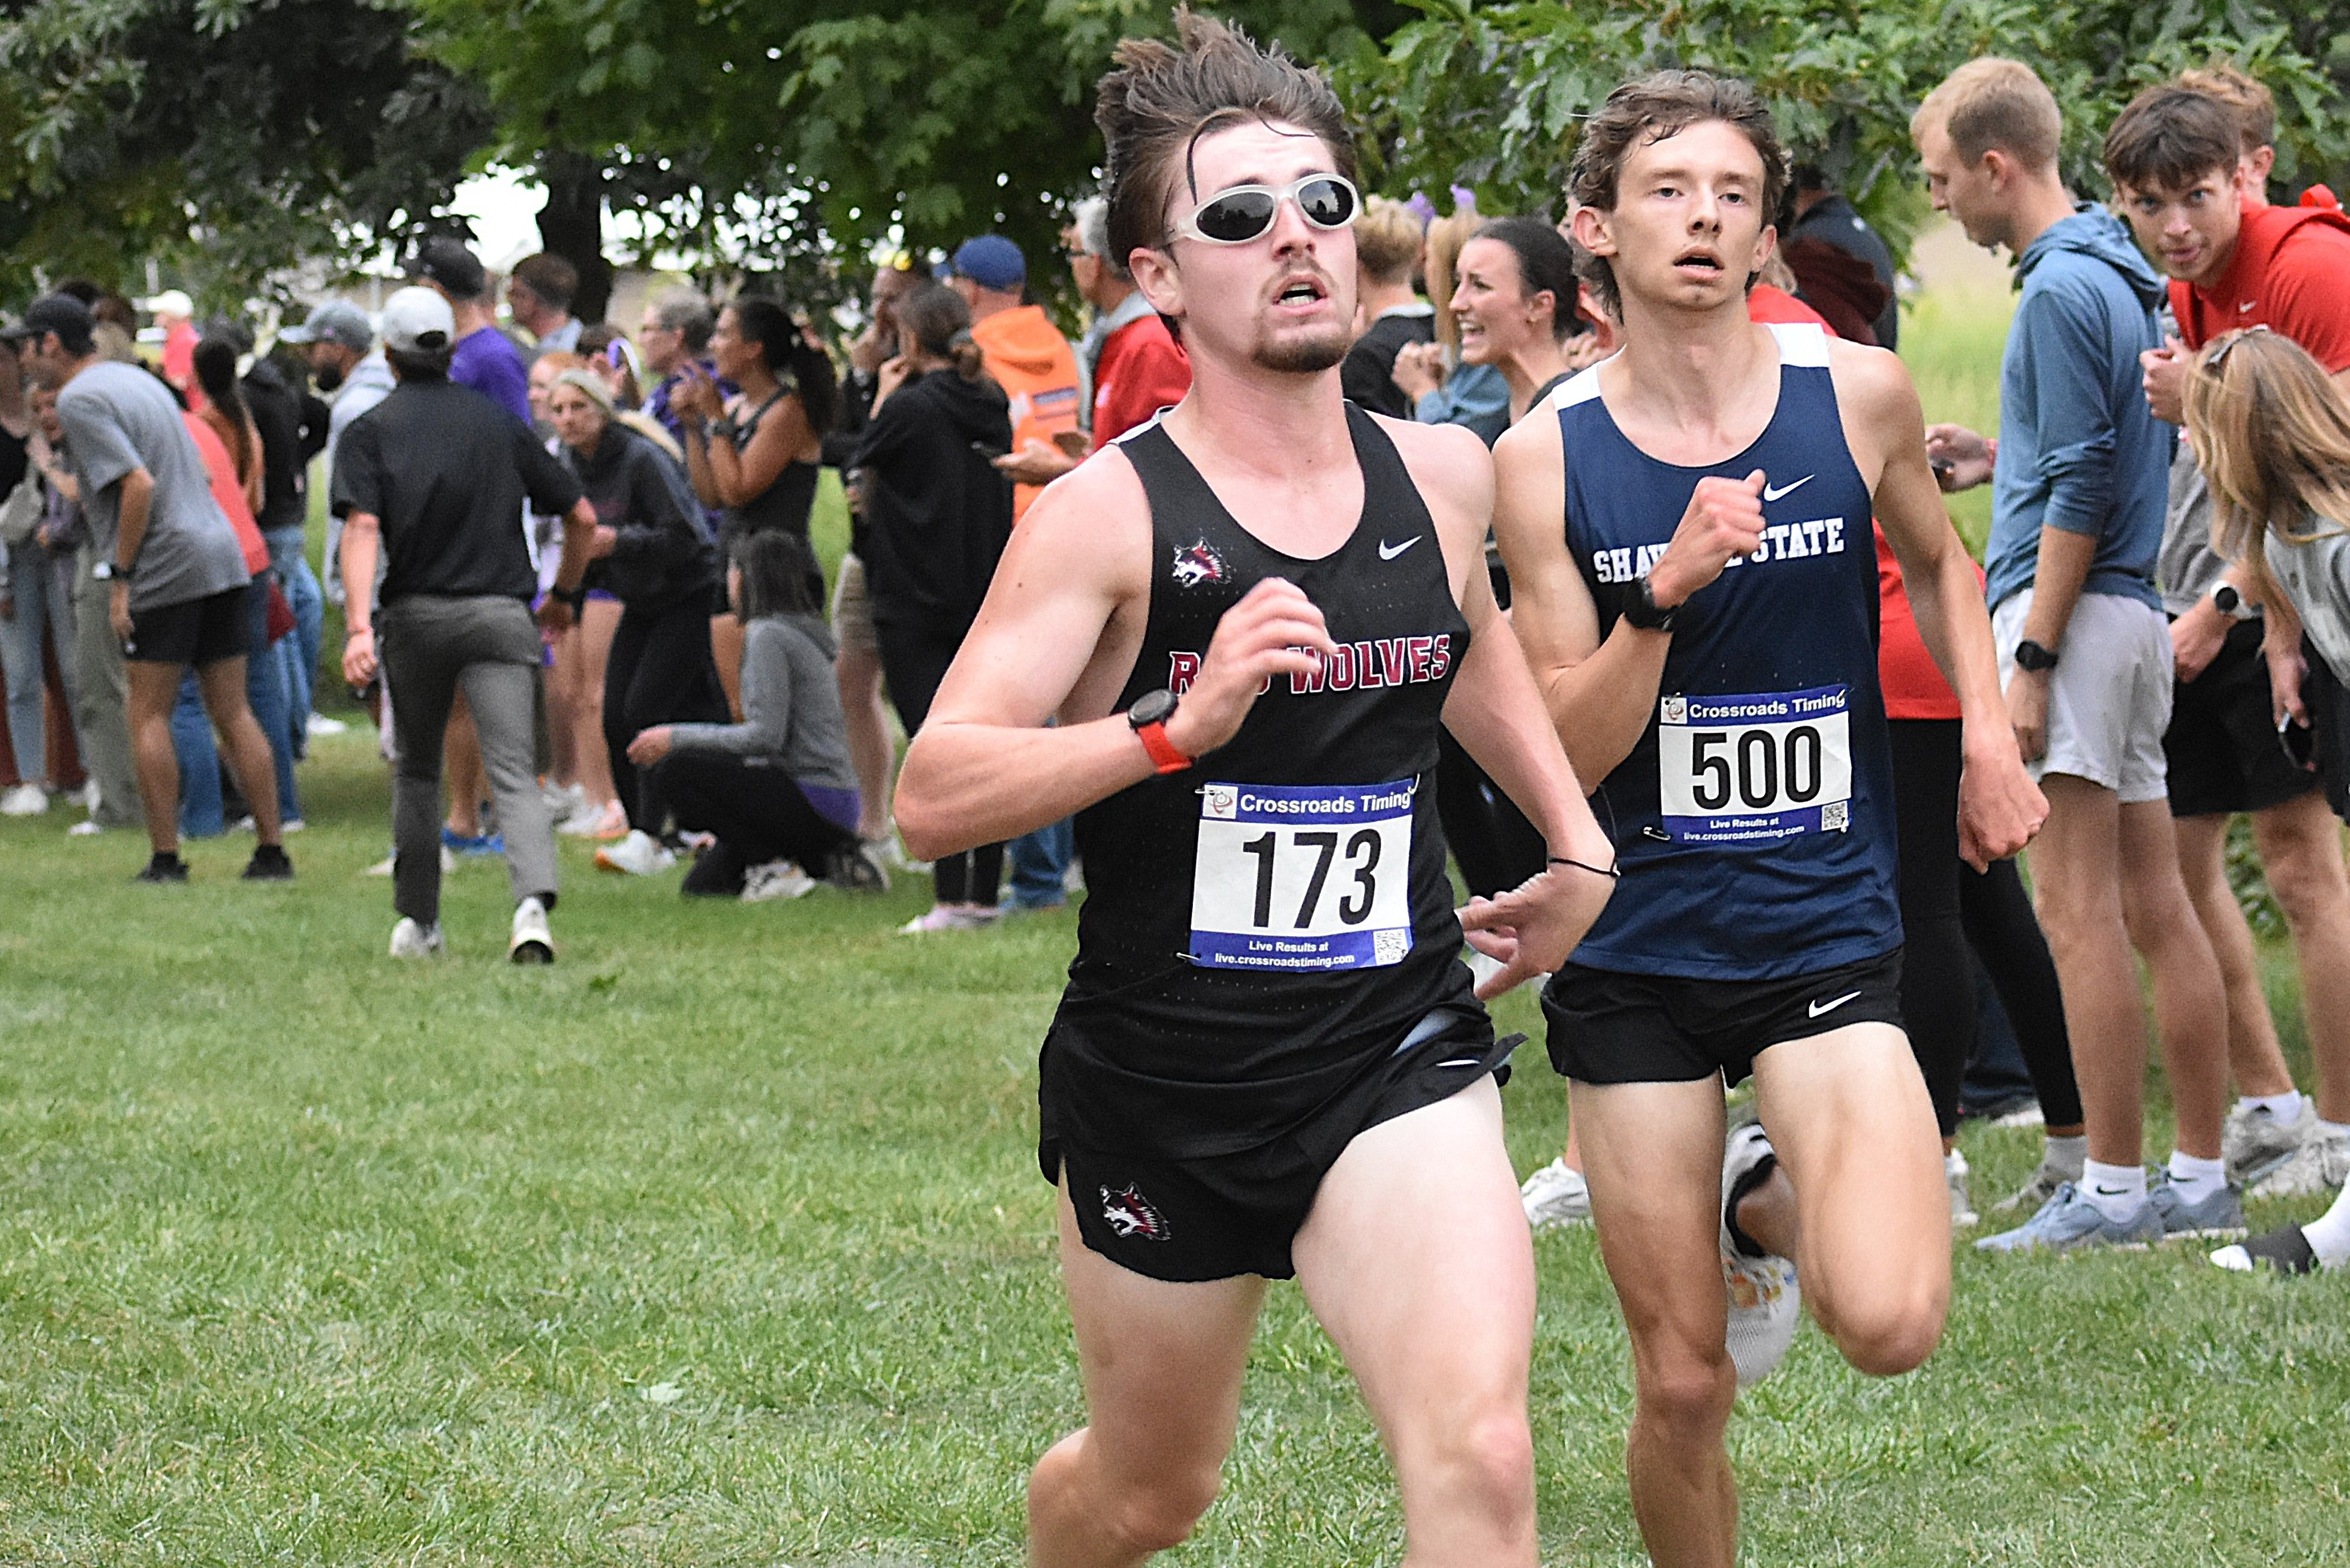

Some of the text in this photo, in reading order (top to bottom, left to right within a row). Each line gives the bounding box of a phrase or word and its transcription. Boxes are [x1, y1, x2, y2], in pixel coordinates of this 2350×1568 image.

[1751, 517, 1844, 563] STATE
[1689, 691, 1845, 718] Crossroads Timing
[1692, 725, 1821, 810] 500
[1240, 791, 1411, 814] Crossroads Timing
[1684, 826, 1805, 841] live.crossroadstiming.com
[1710, 817, 1779, 829] Live Results at
[1242, 828, 1382, 929] 173
[1249, 940, 1329, 953] Live Results at
[1215, 953, 1355, 968] live.crossroadstiming.com
